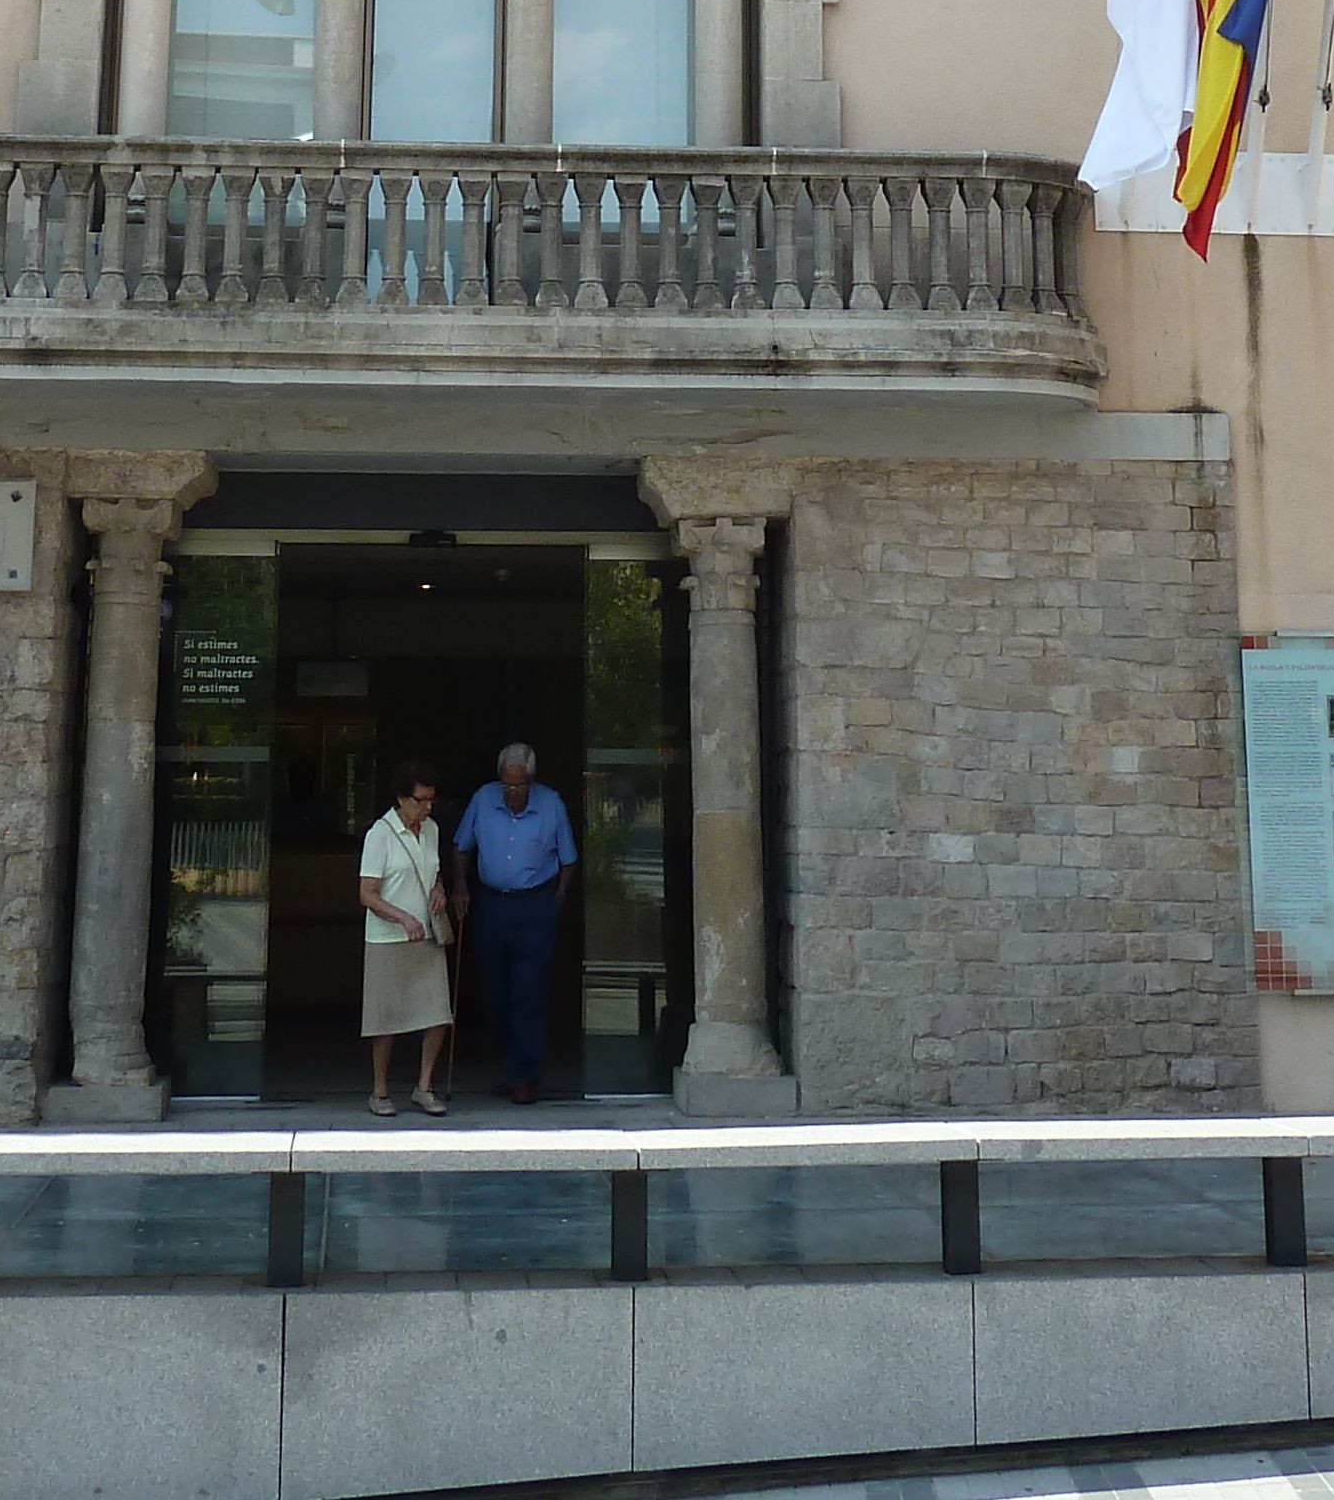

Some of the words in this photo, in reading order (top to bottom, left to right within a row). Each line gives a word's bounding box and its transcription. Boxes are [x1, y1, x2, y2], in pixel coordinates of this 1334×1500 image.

[183, 639, 194, 649] Si
[197, 639, 238, 649] estimes
[183, 655, 197, 663] no
[182, 668, 194, 678] Si
[197, 668, 253, 678] maltractes
[182, 684, 196, 692] no
[199, 682, 240, 693] estimes
